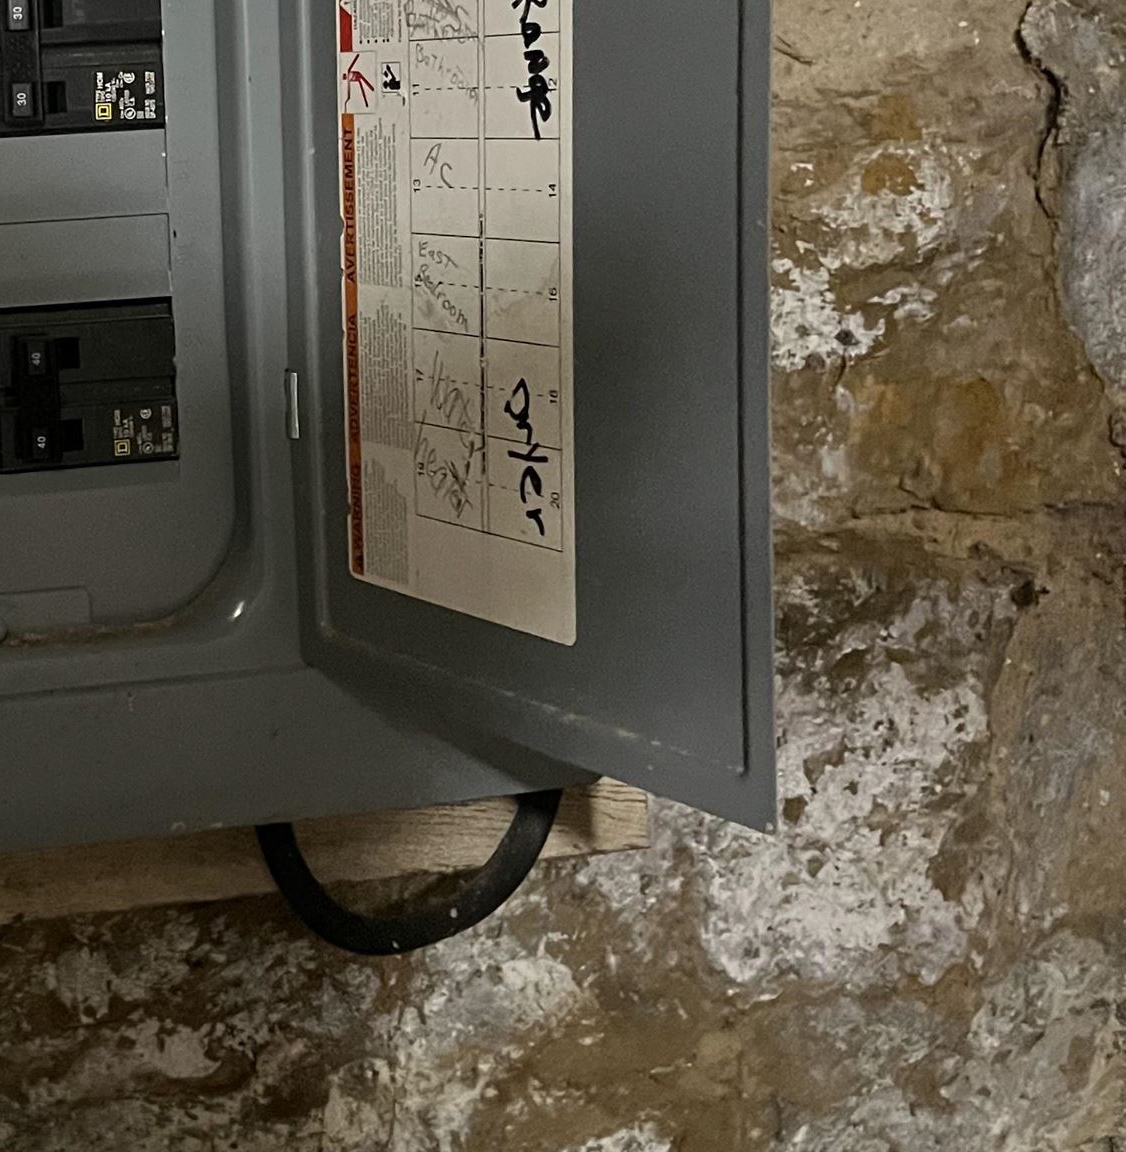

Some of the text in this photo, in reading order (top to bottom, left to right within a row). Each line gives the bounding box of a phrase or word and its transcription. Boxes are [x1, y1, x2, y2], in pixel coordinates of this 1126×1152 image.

[13, 6, 23, 20] 30
[106, 93, 111, 102] 10
[412, 84, 419, 96] 11
[17, 91, 26, 106] 30
[412, 179, 421, 193] 13
[549, 183, 557, 198] 14
[344, 128, 357, 285] AVERTISSEMENT
[549, 287, 557, 302] 16
[31, 351, 42, 366] 40
[346, 313, 359, 444] ADVERTENCIA
[416, 369, 425, 382] 17
[550, 389, 558, 404] 18
[37, 435, 47, 449] 40
[417, 462, 426, 476] 19
[550, 492, 560, 509] 20
